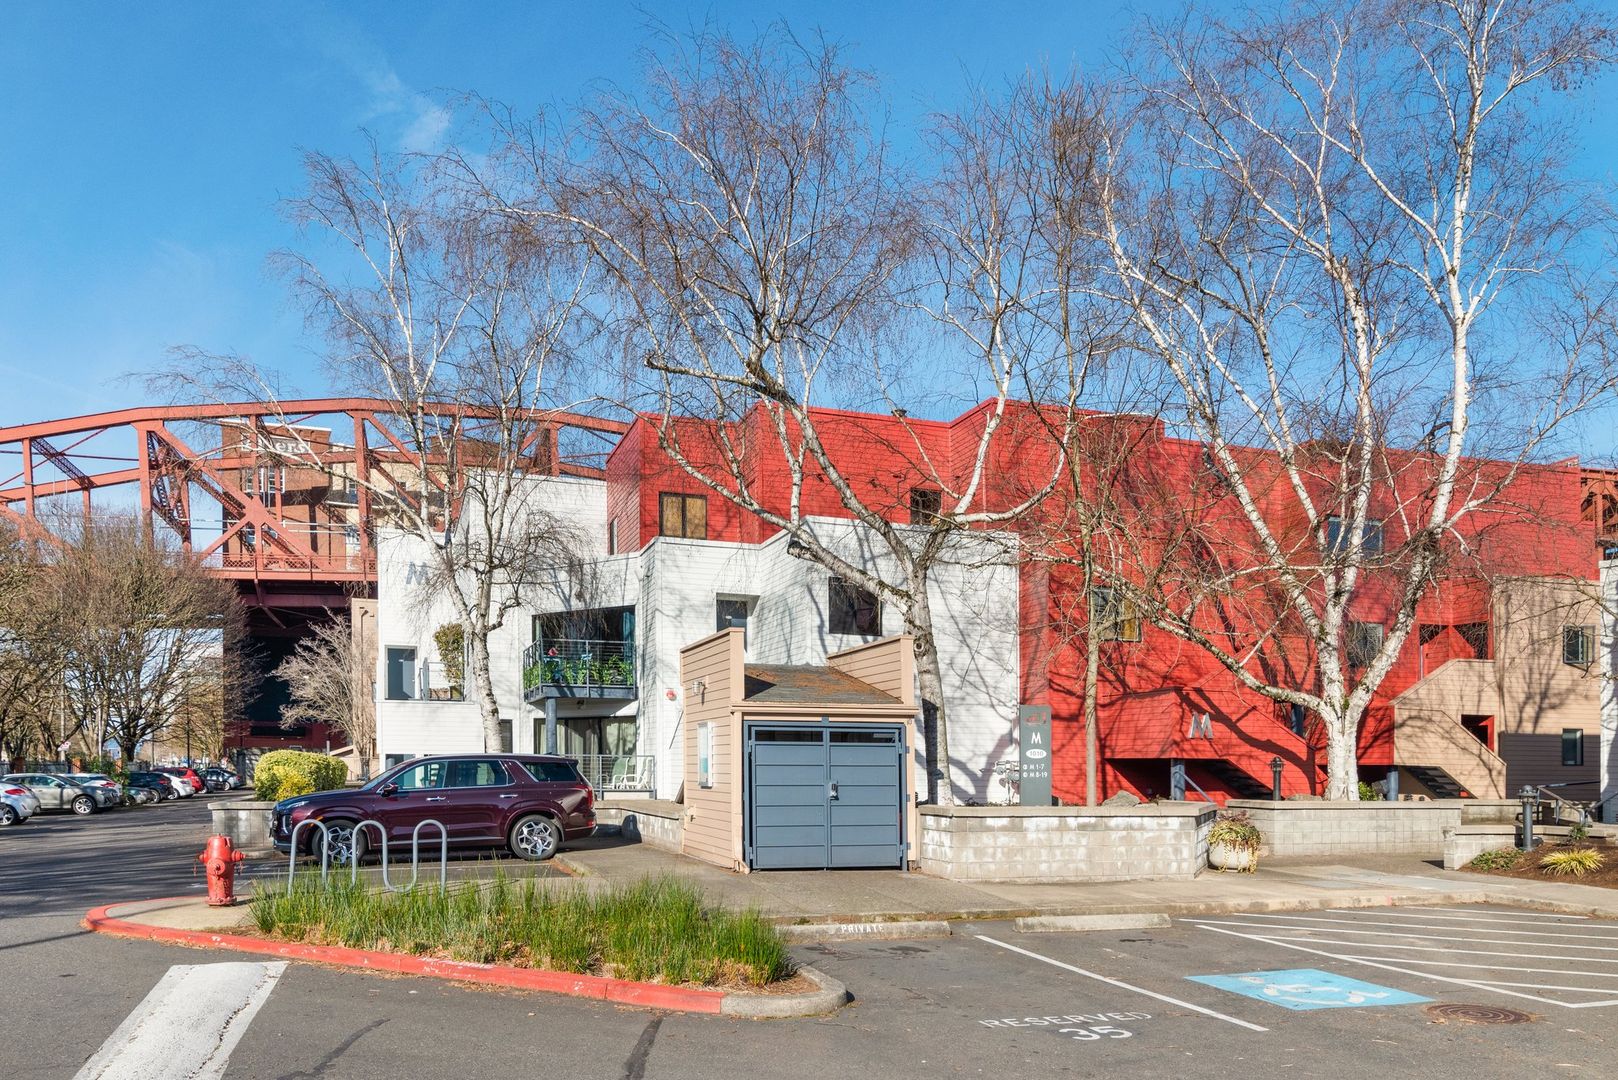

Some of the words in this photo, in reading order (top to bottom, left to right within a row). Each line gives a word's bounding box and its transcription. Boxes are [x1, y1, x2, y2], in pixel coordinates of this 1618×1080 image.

[406, 562, 430, 585] M
[1188, 711, 1214, 739] M
[1031, 732, 1042, 744] M
[840, 924, 884, 933] PRIVATE
[978, 1011, 1152, 1028] RESERVED
[1059, 1025, 1133, 1041] 35
